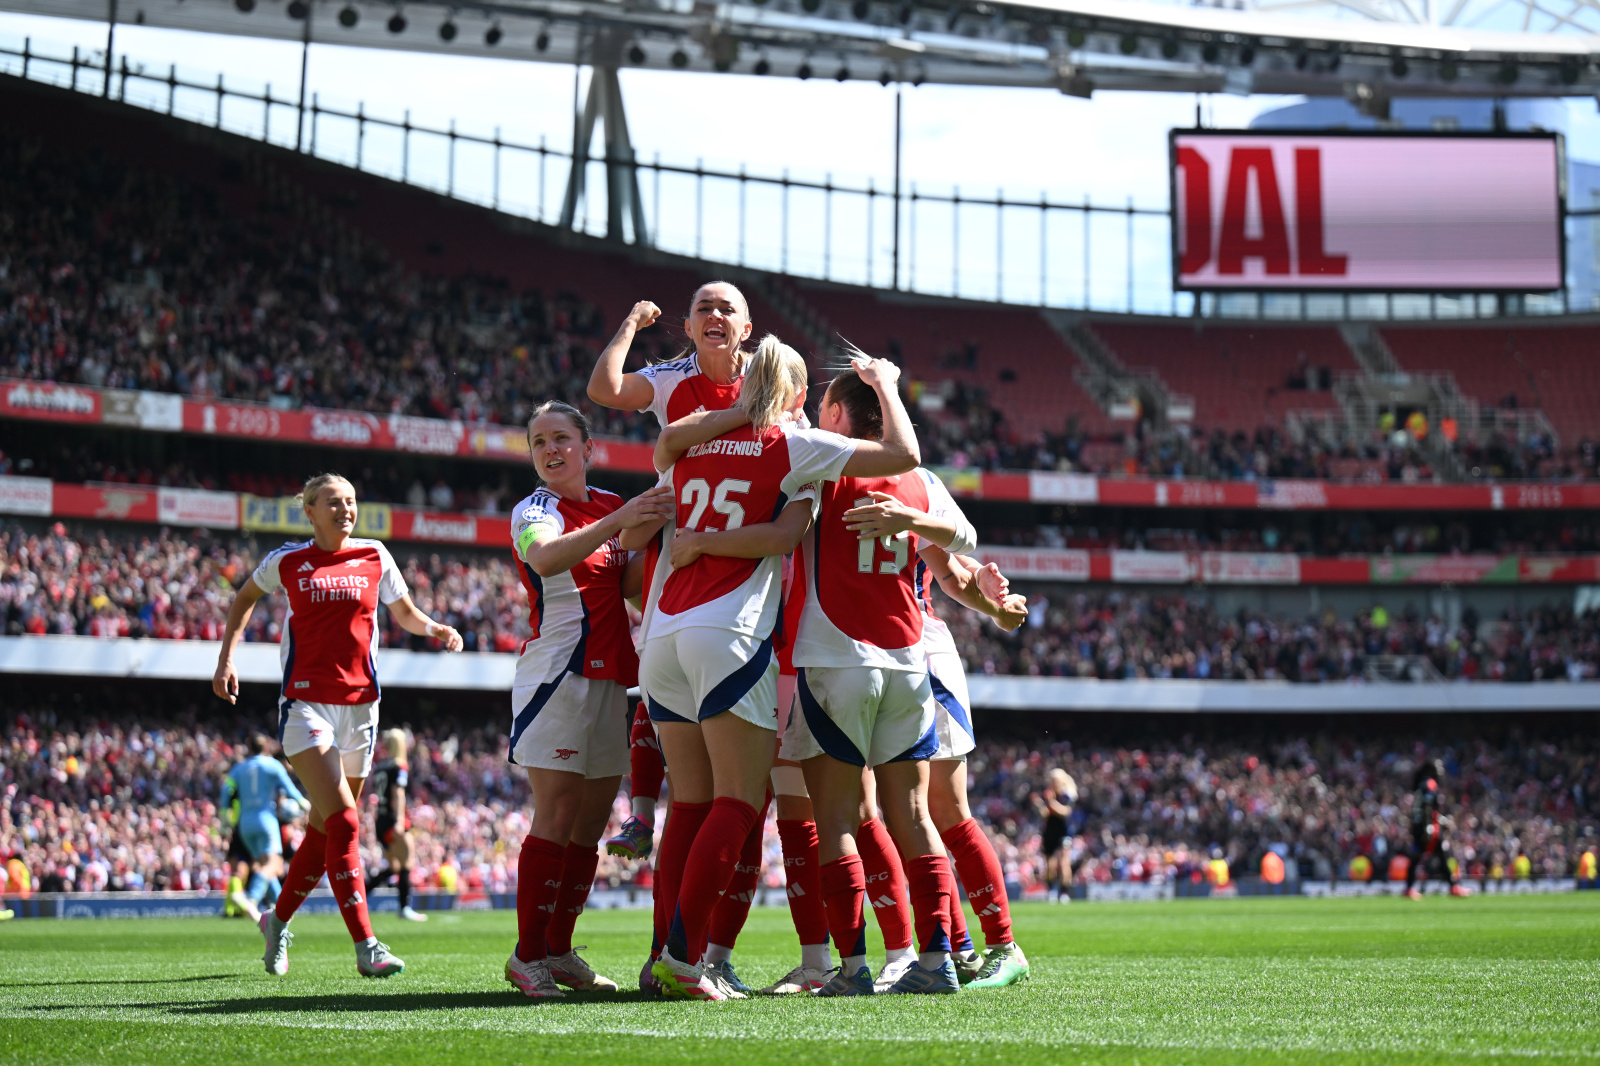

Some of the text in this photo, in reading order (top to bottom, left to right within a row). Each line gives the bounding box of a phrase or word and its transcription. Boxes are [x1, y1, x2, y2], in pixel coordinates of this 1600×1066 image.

[227, 408, 280, 437] 2003
[686, 439, 763, 457] BLACKSTENIUS
[681, 477, 752, 532] 25
[1518, 485, 1563, 508] 2015
[411, 513, 477, 540] Arsenal
[298, 575, 369, 592] Emirates
[311, 588, 362, 602] FLY BETTER
[336, 868, 359, 880] AFC
[865, 871, 889, 884] AFC
[545, 880, 562, 888] AF
[968, 884, 994, 898] AFC
